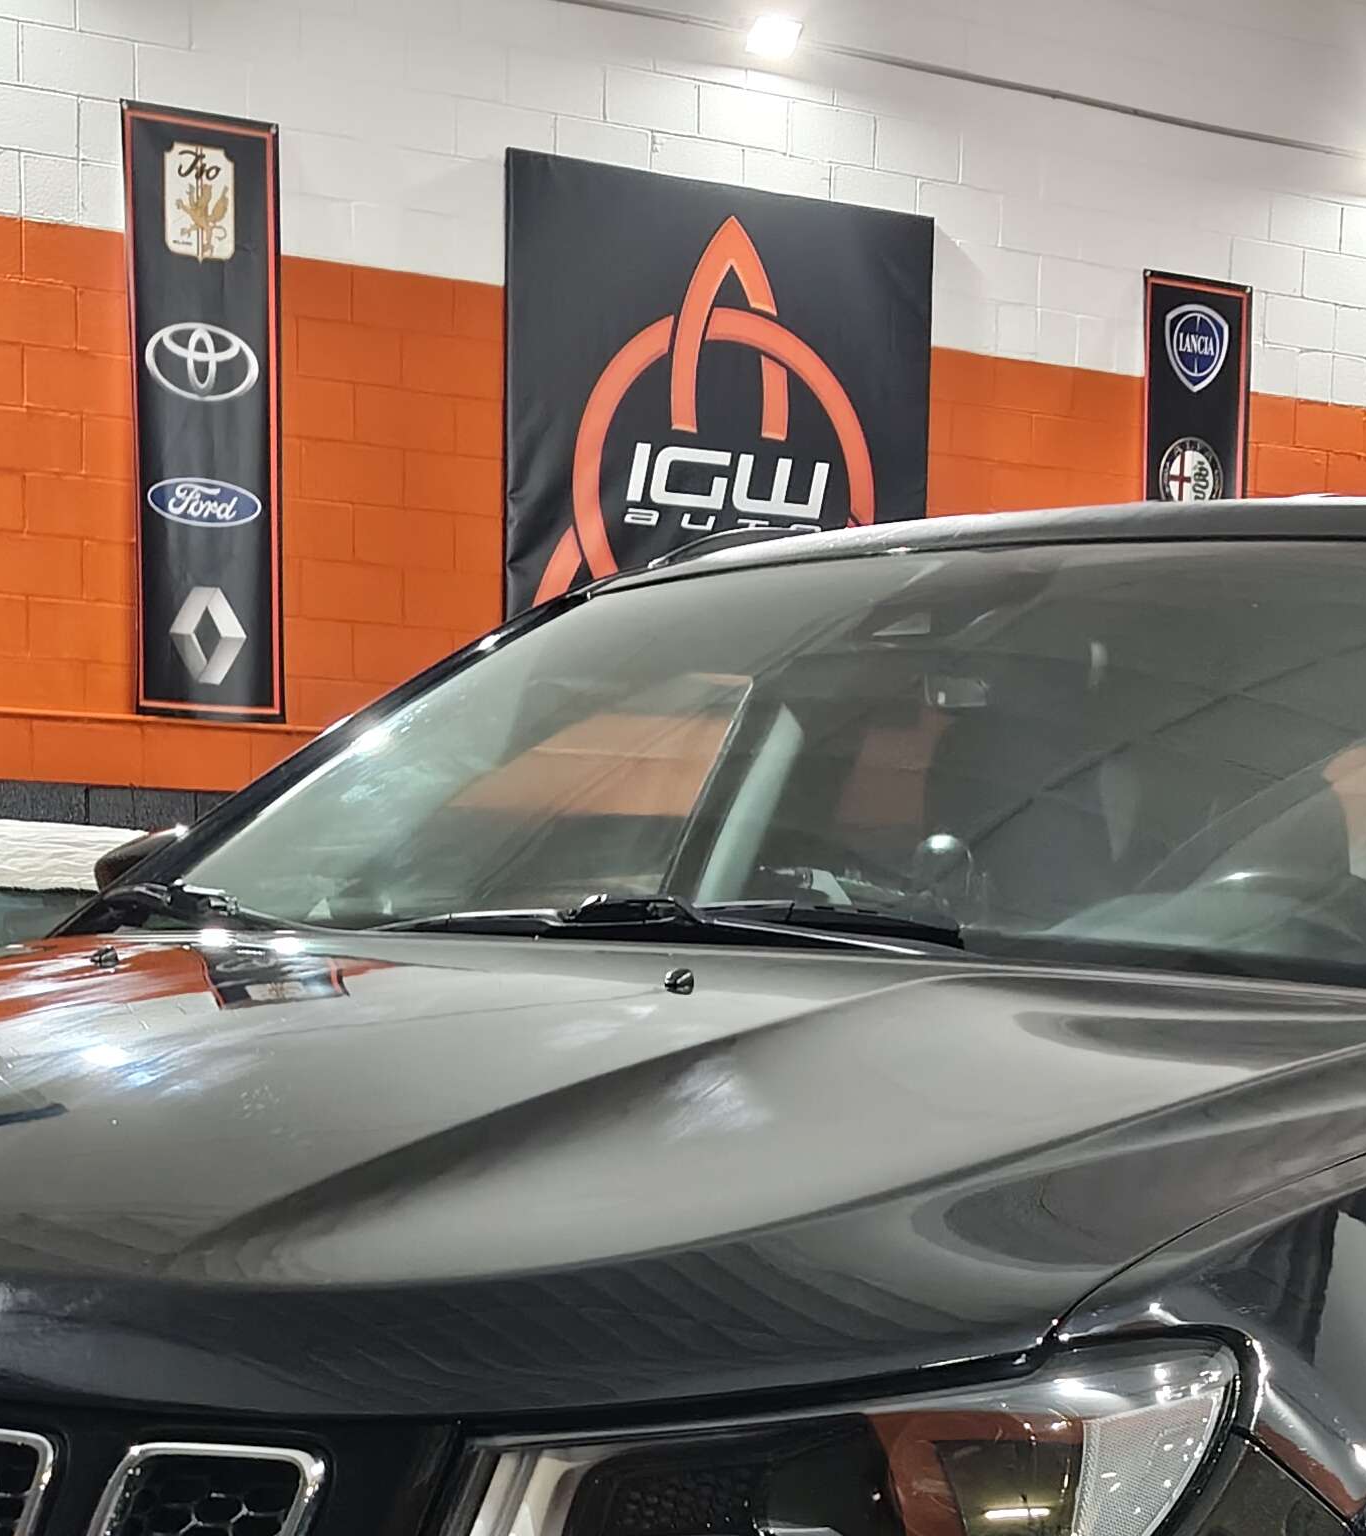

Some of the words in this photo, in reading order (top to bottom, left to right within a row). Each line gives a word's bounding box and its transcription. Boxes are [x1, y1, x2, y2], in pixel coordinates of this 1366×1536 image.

[1178, 331, 1215, 357] LANCIA
[626, 442, 830, 519] IGW
[167, 483, 239, 521] Ford
